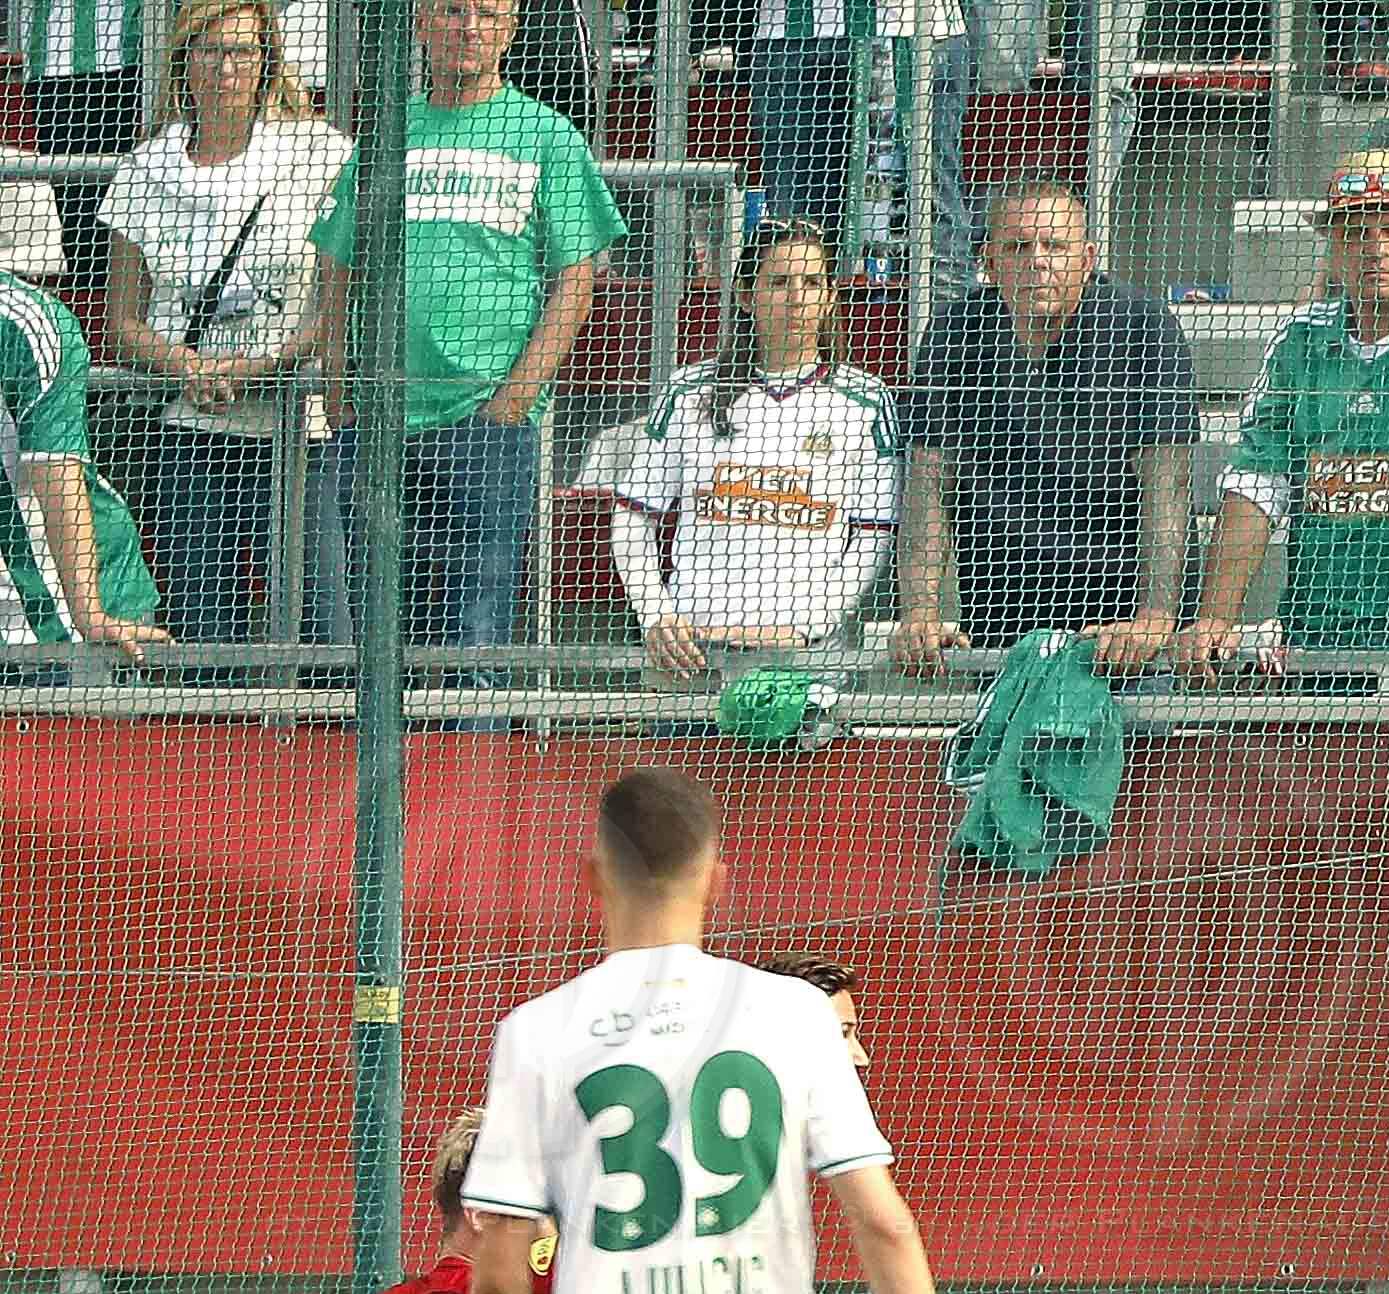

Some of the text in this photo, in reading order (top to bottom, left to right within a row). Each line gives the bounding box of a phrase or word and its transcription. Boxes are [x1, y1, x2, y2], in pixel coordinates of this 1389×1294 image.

[719, 465, 811, 496] WIEN
[697, 495, 831, 529] ENERGIE
[575, 1050, 783, 1251] 39
